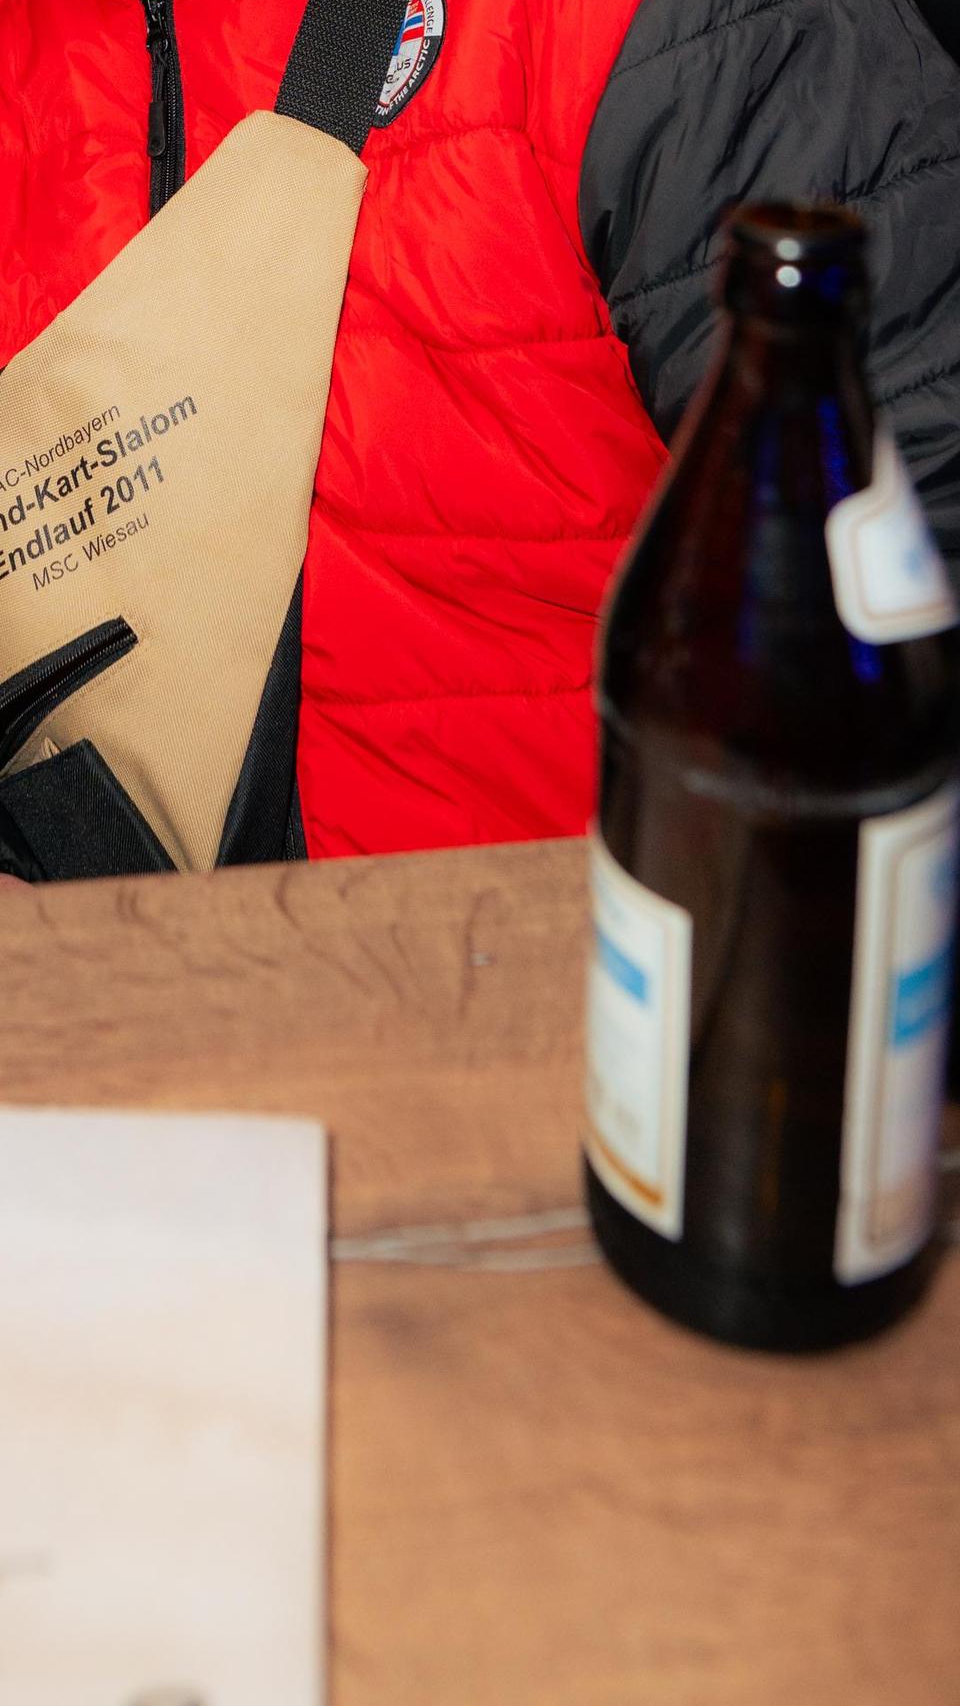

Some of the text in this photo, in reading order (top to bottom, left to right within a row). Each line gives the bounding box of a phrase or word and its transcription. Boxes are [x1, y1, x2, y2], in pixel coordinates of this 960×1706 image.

[408, 39, 430, 87] ARCTIC
[100, 455, 164, 515] 2011
[32, 513, 149, 591] MSC Wiesau
